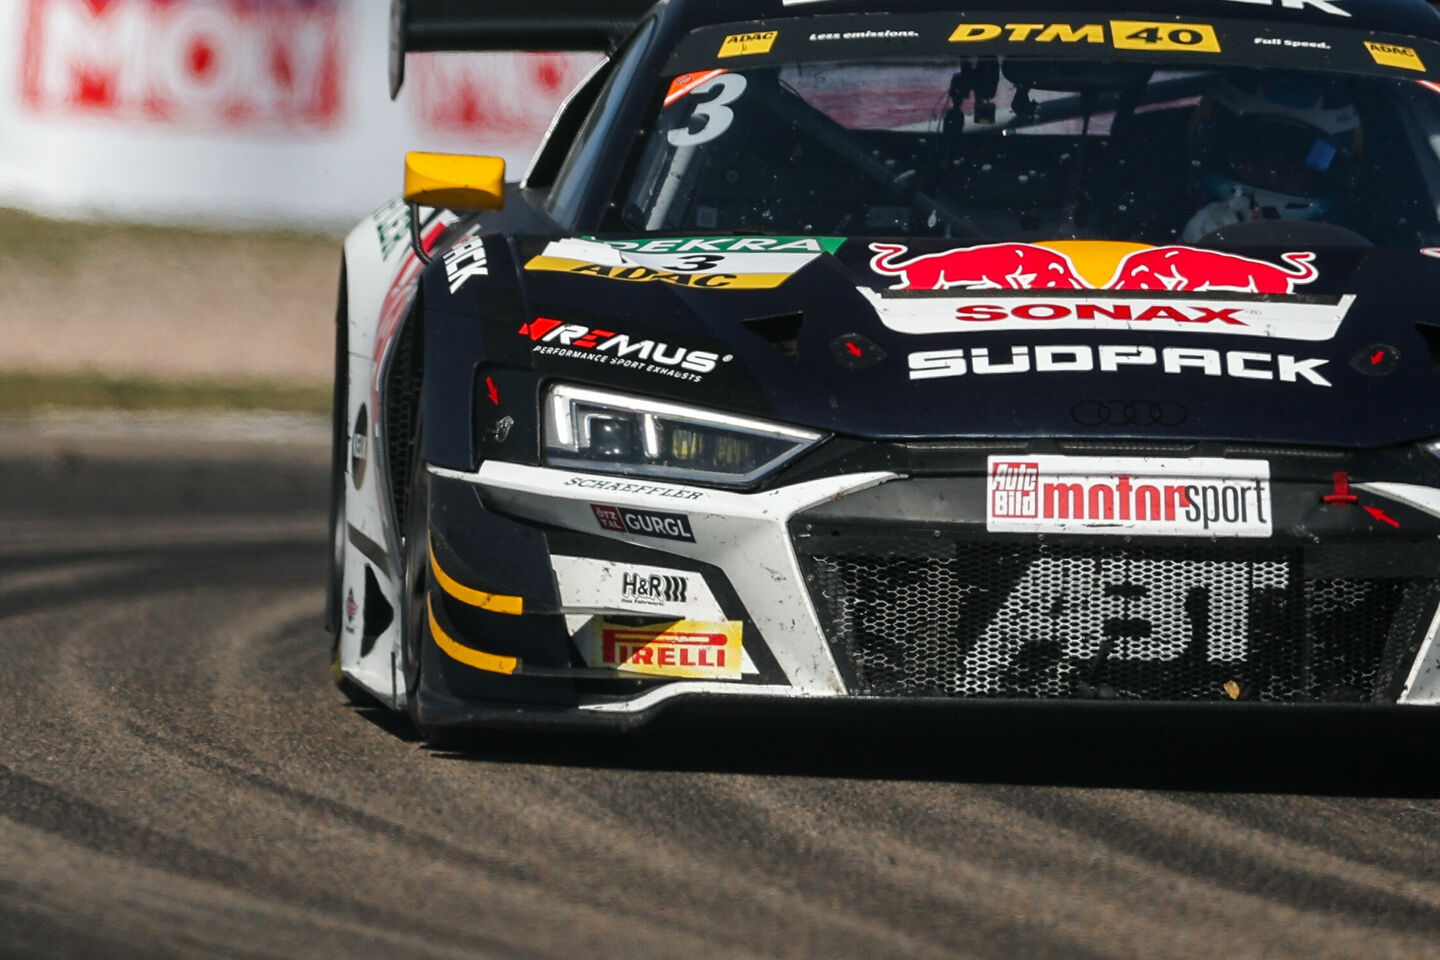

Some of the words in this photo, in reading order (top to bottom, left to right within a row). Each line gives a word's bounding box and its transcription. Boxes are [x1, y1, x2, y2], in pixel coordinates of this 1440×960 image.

[727, 31, 774, 44] ADAC
[948, 23, 1105, 43] DTM
[1126, 26, 1204, 46] 40
[1369, 44, 1415, 58] ADAC
[667, 72, 747, 147] 3
[569, 263, 737, 288] ADAC
[662, 254, 726, 272] 3
[955, 303, 1249, 327] SONAX
[541, 324, 720, 373] REMUS
[532, 344, 608, 364] PERFORMANCE
[609, 357, 646, 371] SPORT
[646, 364, 704, 383] EXHAUSTS
[564, 477, 703, 500] SCHAEFFLER
[993, 463, 1038, 490] Auto
[994, 491, 1036, 516] Bild
[625, 513, 692, 538] GURGL
[622, 571, 664, 599] H&R
[945, 558, 1290, 694] ABT
[602, 629, 728, 668] PIRELLI
